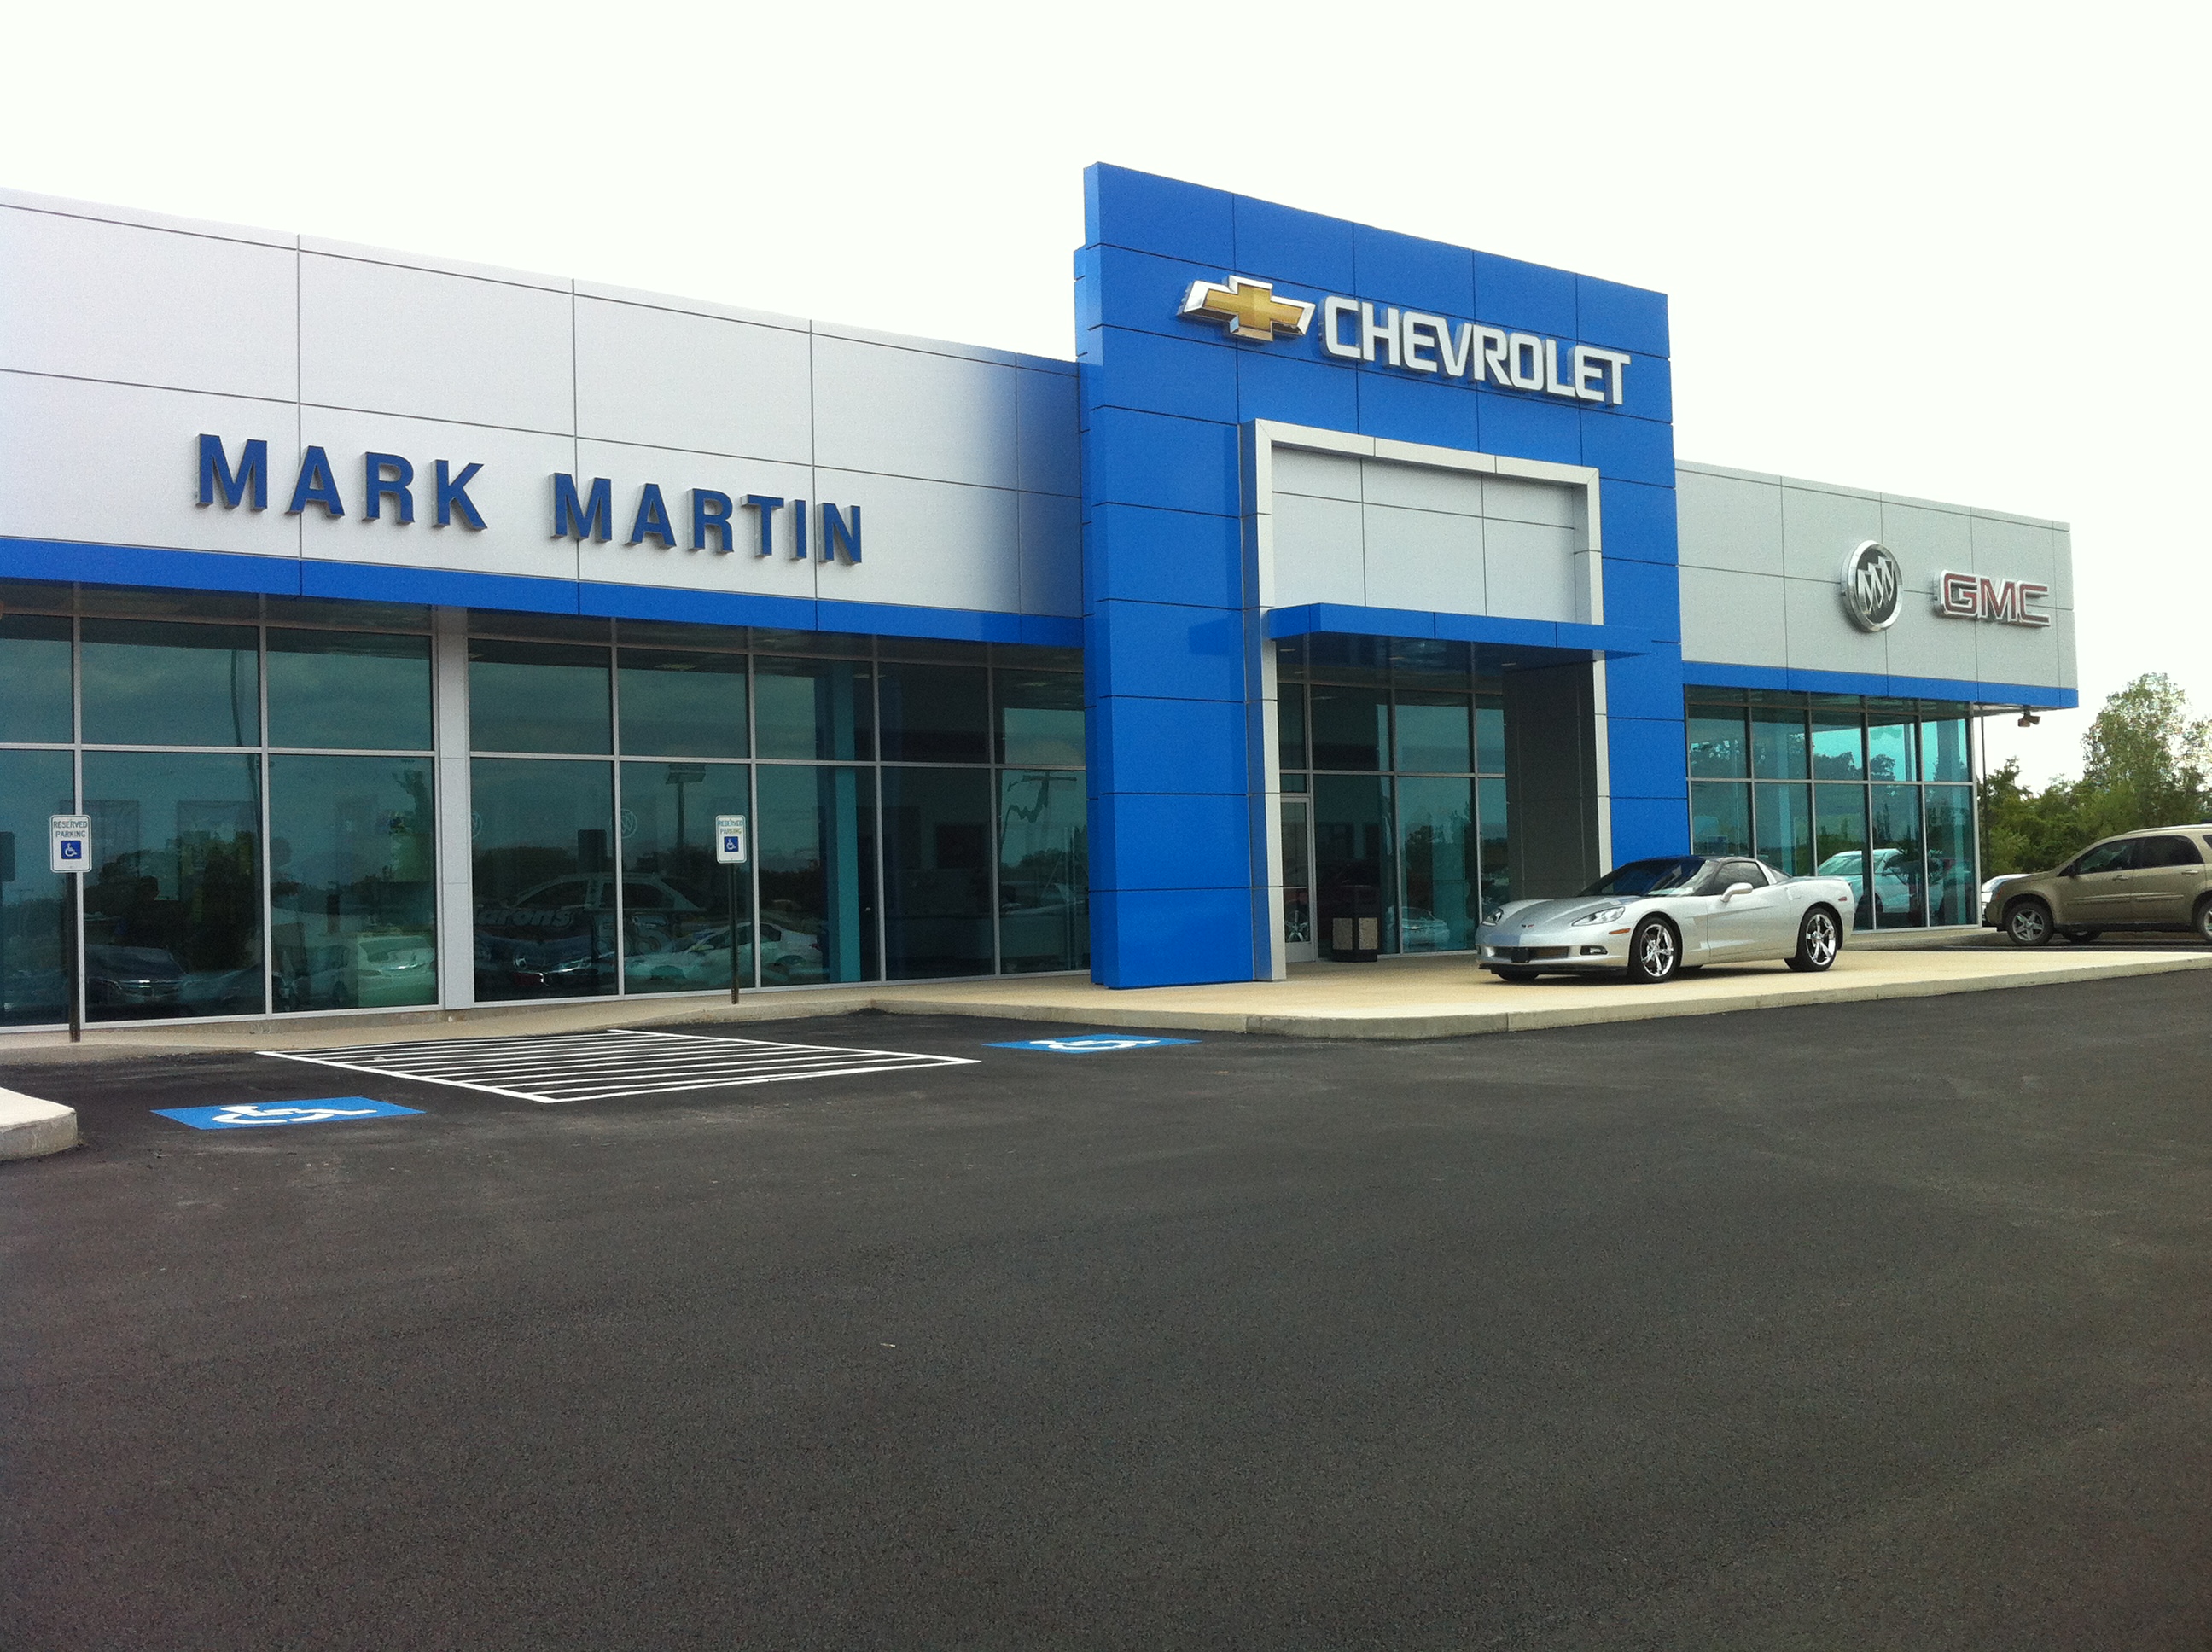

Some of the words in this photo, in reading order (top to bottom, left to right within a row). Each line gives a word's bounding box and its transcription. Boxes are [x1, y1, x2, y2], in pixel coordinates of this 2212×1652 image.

[1318, 295, 1630, 407] CHEVROLET
[195, 433, 488, 531] MARK
[549, 472, 862, 566] MARTIN
[1933, 569, 2051, 628] GMC
[53, 820, 88, 829] RESERVED
